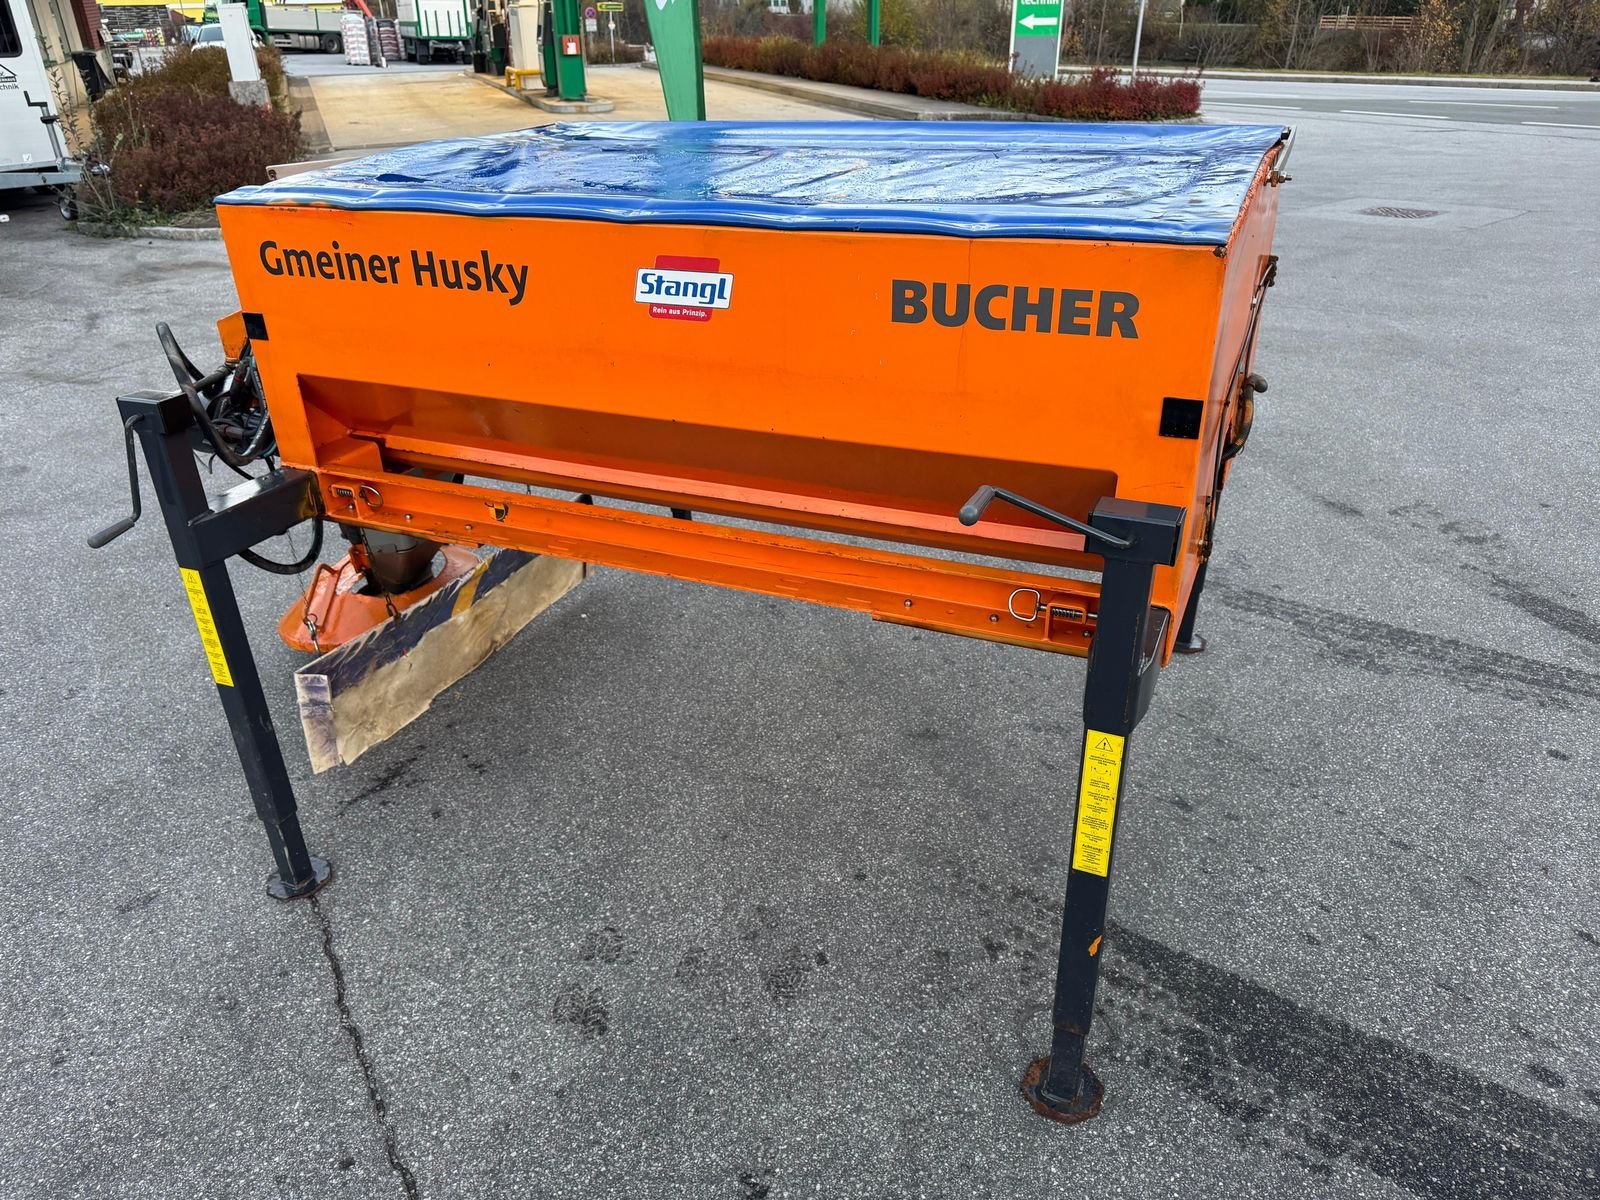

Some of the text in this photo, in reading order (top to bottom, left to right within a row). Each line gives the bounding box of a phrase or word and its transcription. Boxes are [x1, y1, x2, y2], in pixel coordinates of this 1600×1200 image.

[259, 240, 529, 306] Gmeiner Husky
[640, 273, 727, 305] Stangl
[652, 306, 667, 314] Rein
[682, 308, 708, 318] Prinzip.
[891, 279, 1140, 339] BUCHER
